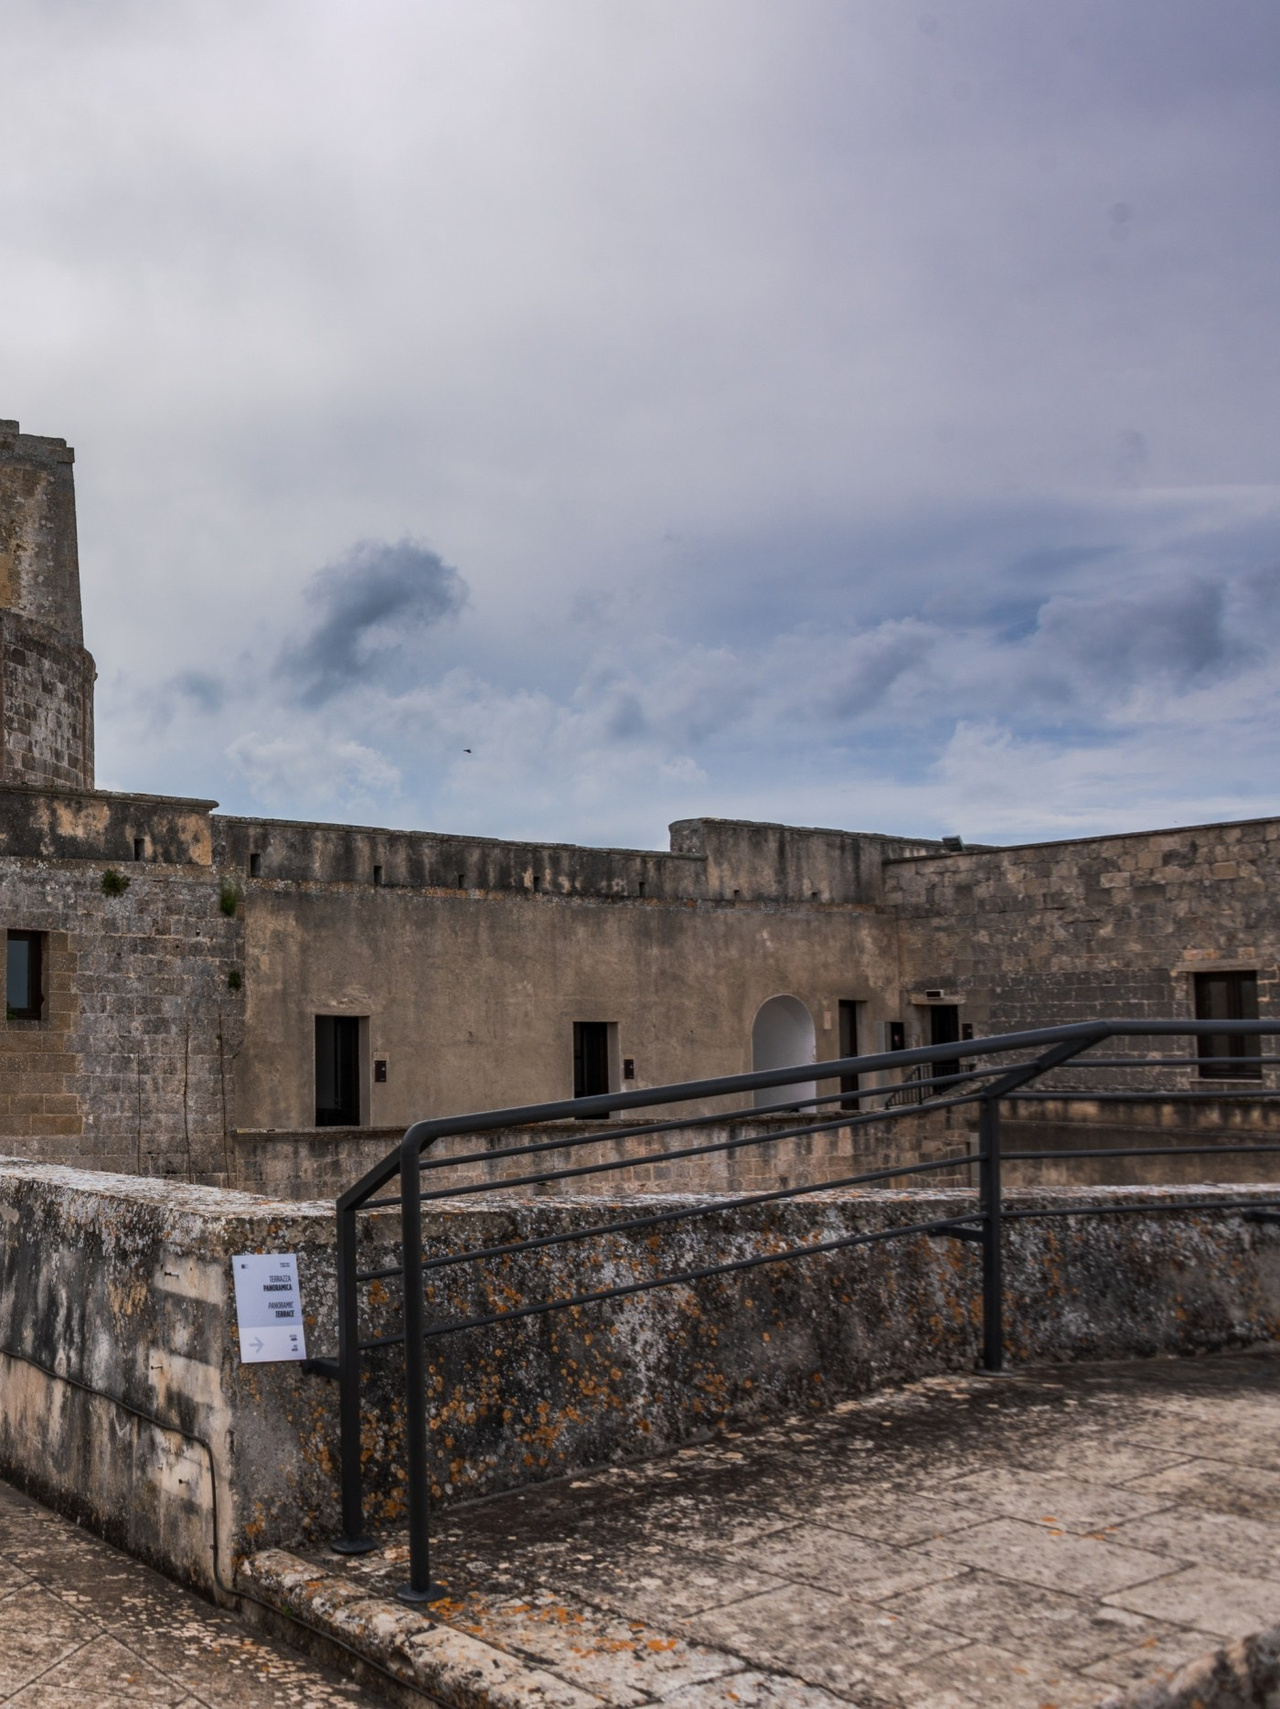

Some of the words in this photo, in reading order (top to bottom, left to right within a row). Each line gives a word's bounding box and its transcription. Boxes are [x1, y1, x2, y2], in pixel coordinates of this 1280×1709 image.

[269, 1275, 291, 1283] TERRAZZA
[263, 1284, 293, 1292] PANORAMICA
[268, 1301, 294, 1309] PANORAMIC
[275, 1310, 295, 1318] TERRACE
